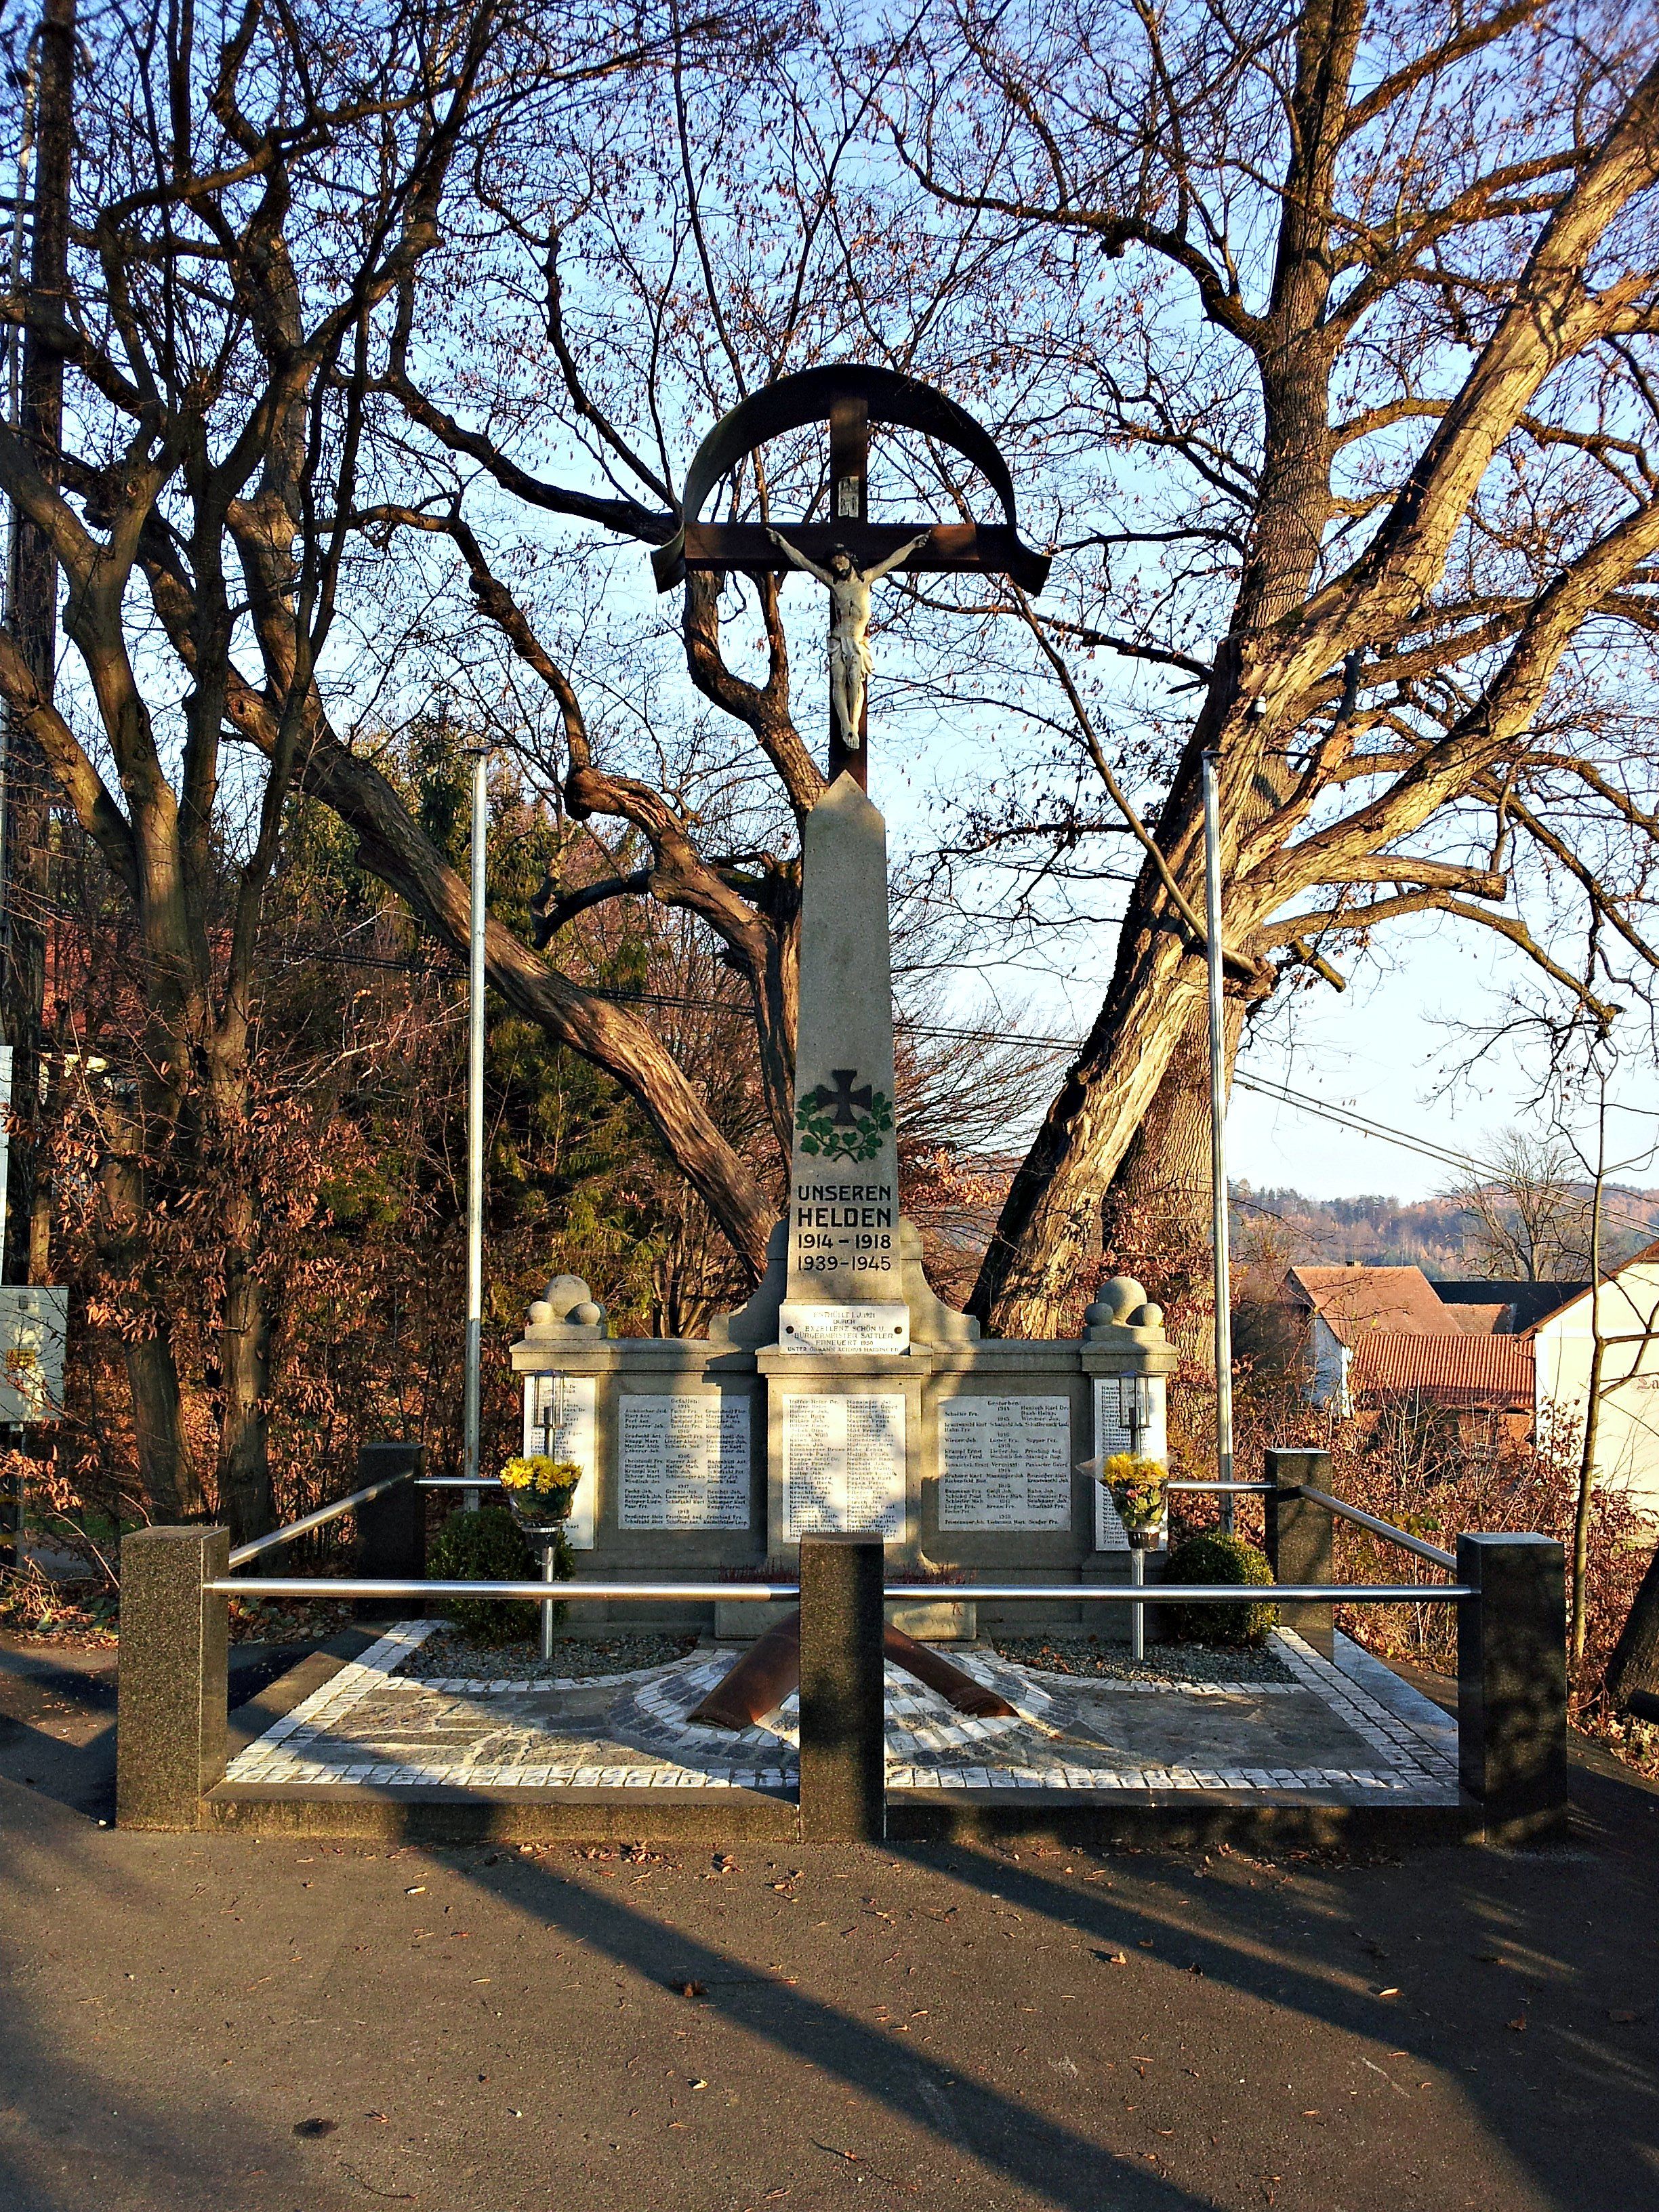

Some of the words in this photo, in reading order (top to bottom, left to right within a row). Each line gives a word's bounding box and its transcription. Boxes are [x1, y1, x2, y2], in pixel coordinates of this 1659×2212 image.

[798, 1185, 890, 1201] UNSEREN
[798, 1208, 890, 1227] HELDEN
[798, 1234, 833, 1248] 1914
[856, 1234, 890, 1248] 1918
